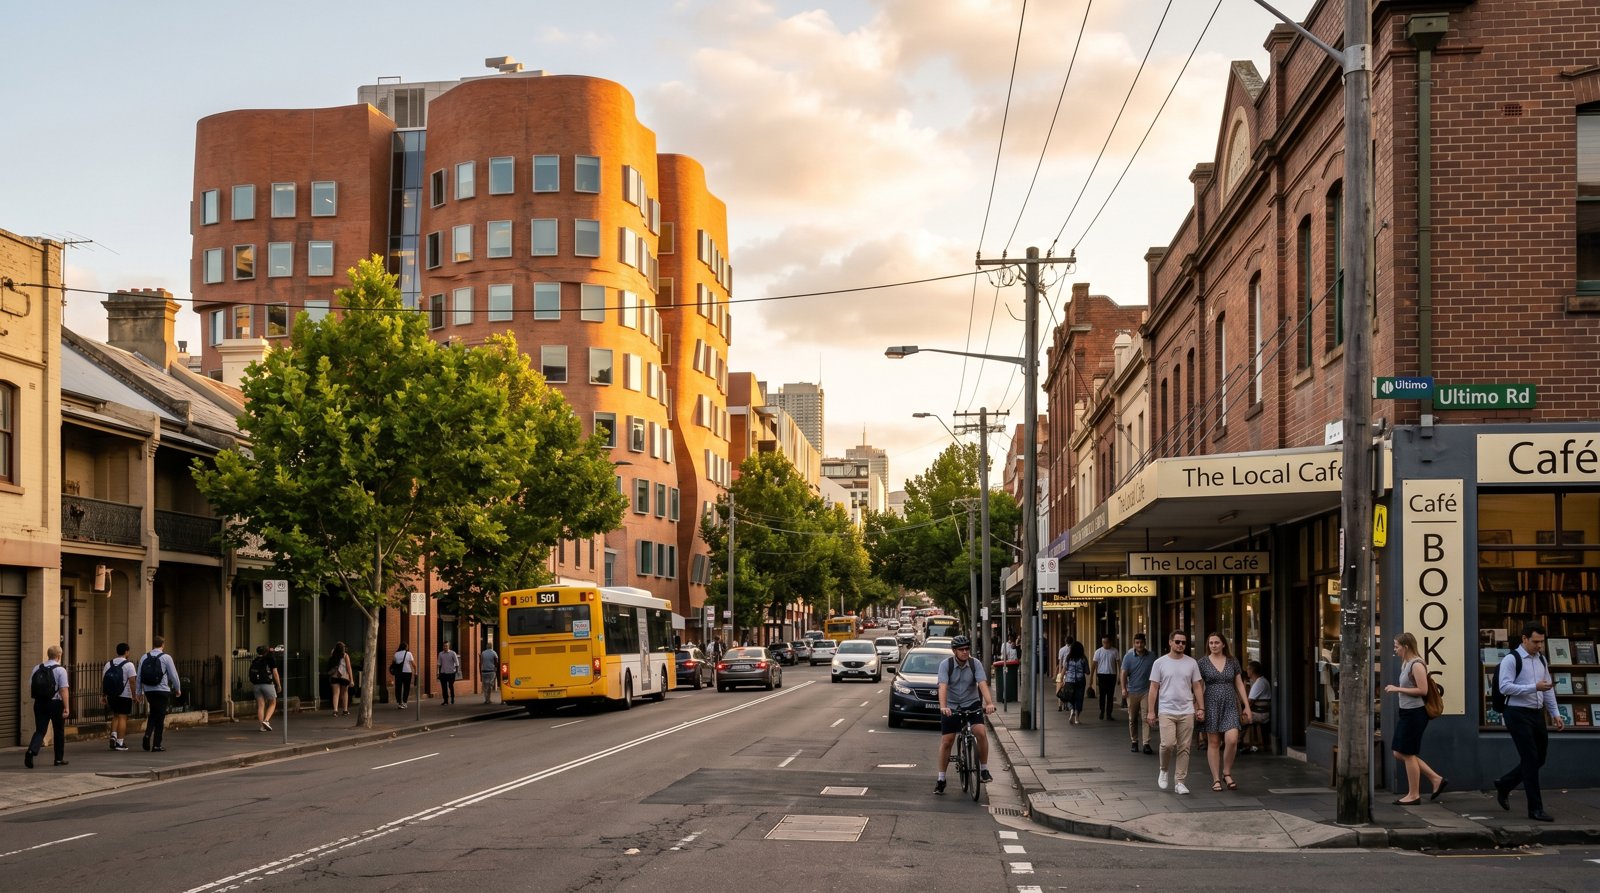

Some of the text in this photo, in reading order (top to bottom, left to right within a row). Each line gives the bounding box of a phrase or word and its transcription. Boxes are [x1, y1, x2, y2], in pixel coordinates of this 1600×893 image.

[1439, 387, 1530, 405] Ultimo Rd
[1508, 439, 1598, 475] Café
[1182, 467, 1224, 488] The
[1232, 462, 1290, 486] Local
[1409, 493, 1457, 513] Café
[1140, 555, 1259, 571] The Local Café
[540, 593, 555, 603] 501
[1078, 584, 1149, 594] Ultimo Books
